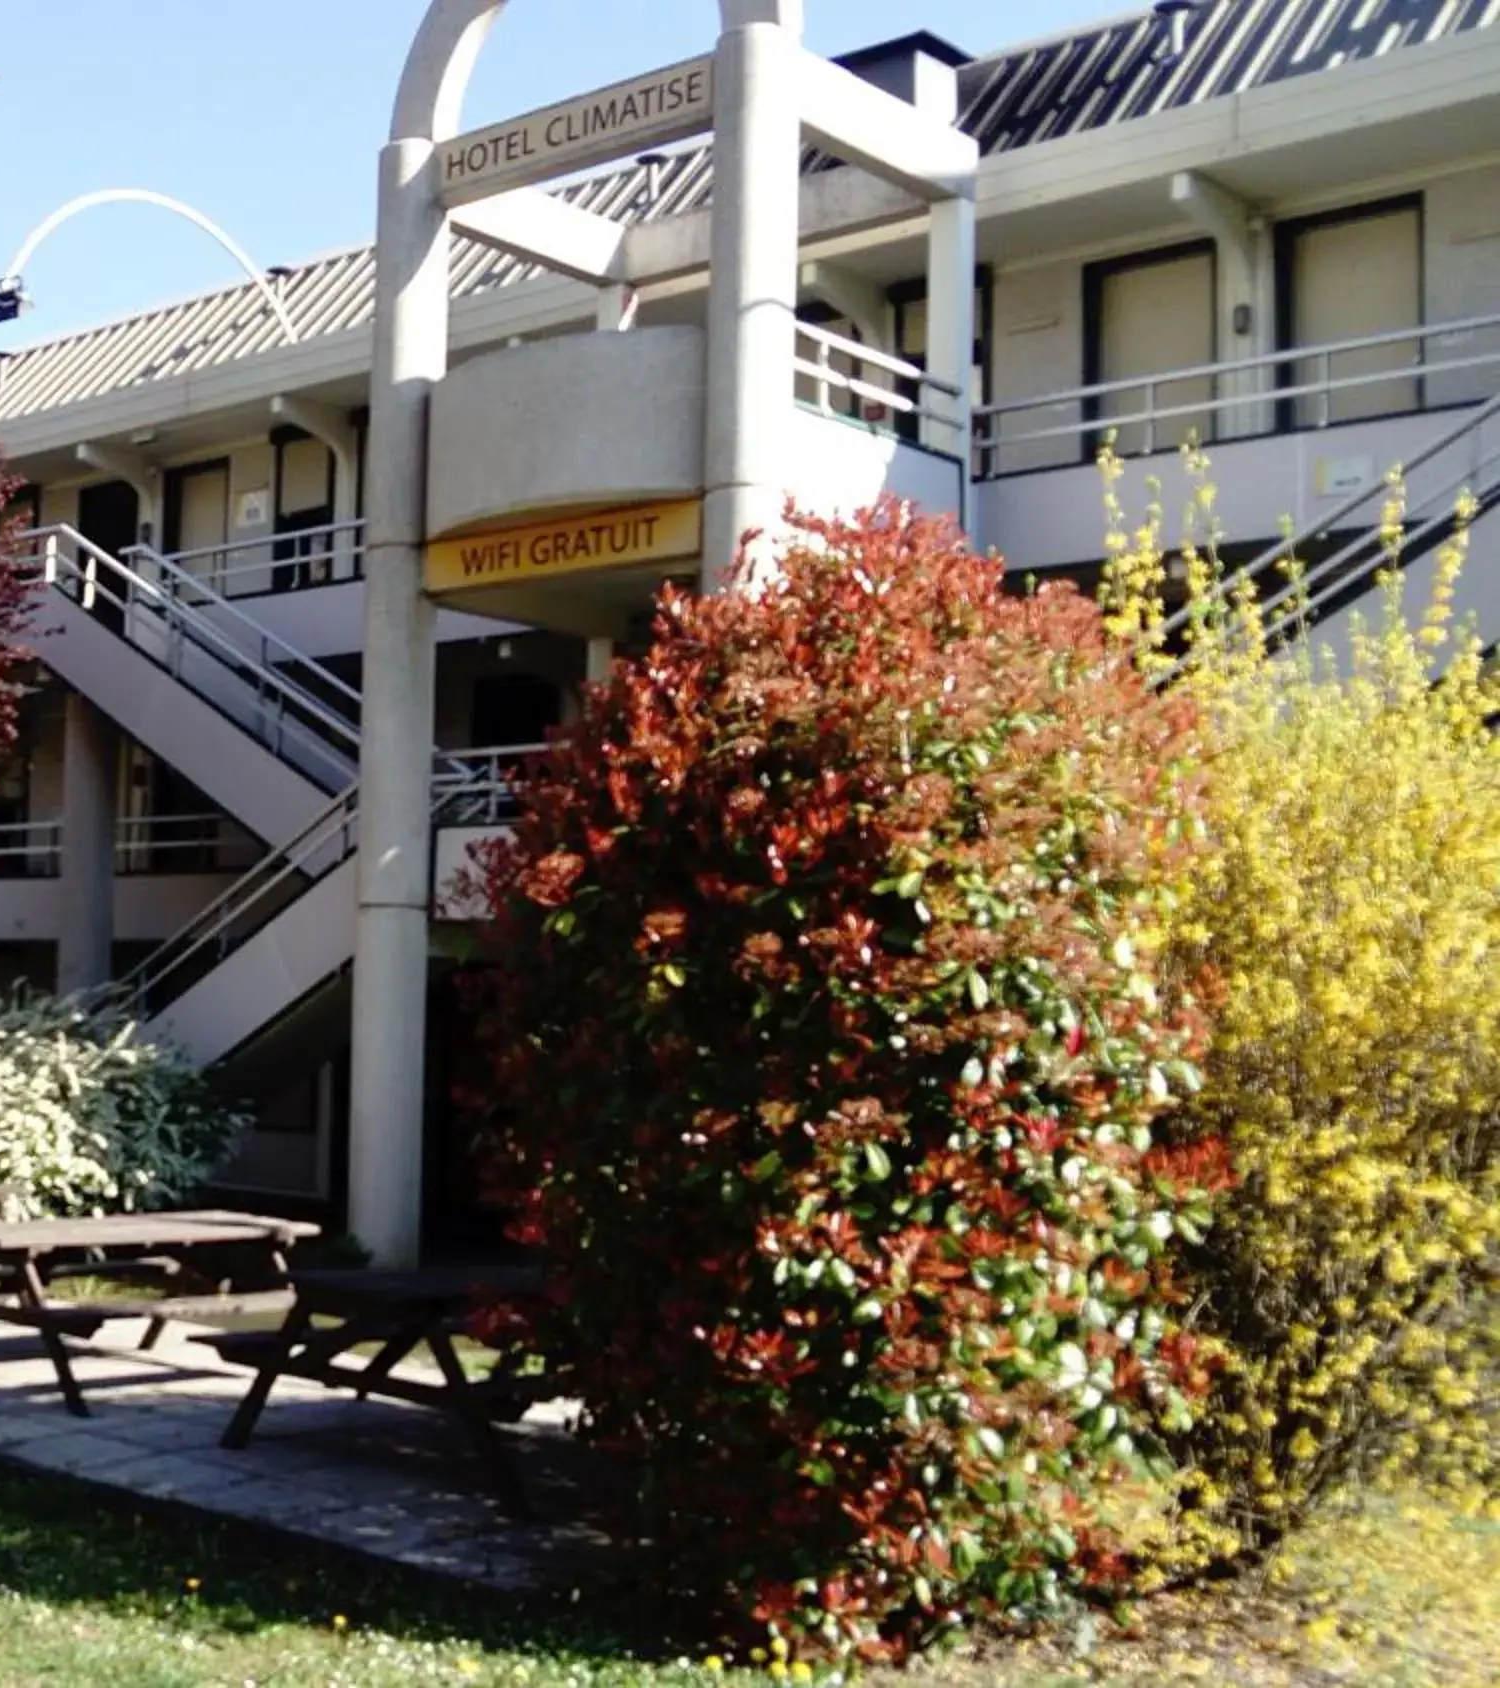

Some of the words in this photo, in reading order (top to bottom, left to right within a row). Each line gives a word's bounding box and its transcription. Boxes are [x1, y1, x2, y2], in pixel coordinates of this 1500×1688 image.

[445, 130, 536, 180] HOTEL
[545, 70, 704, 148] CLIMATISE
[460, 540, 520, 577] WIFI
[529, 516, 660, 566] GRATUIT
